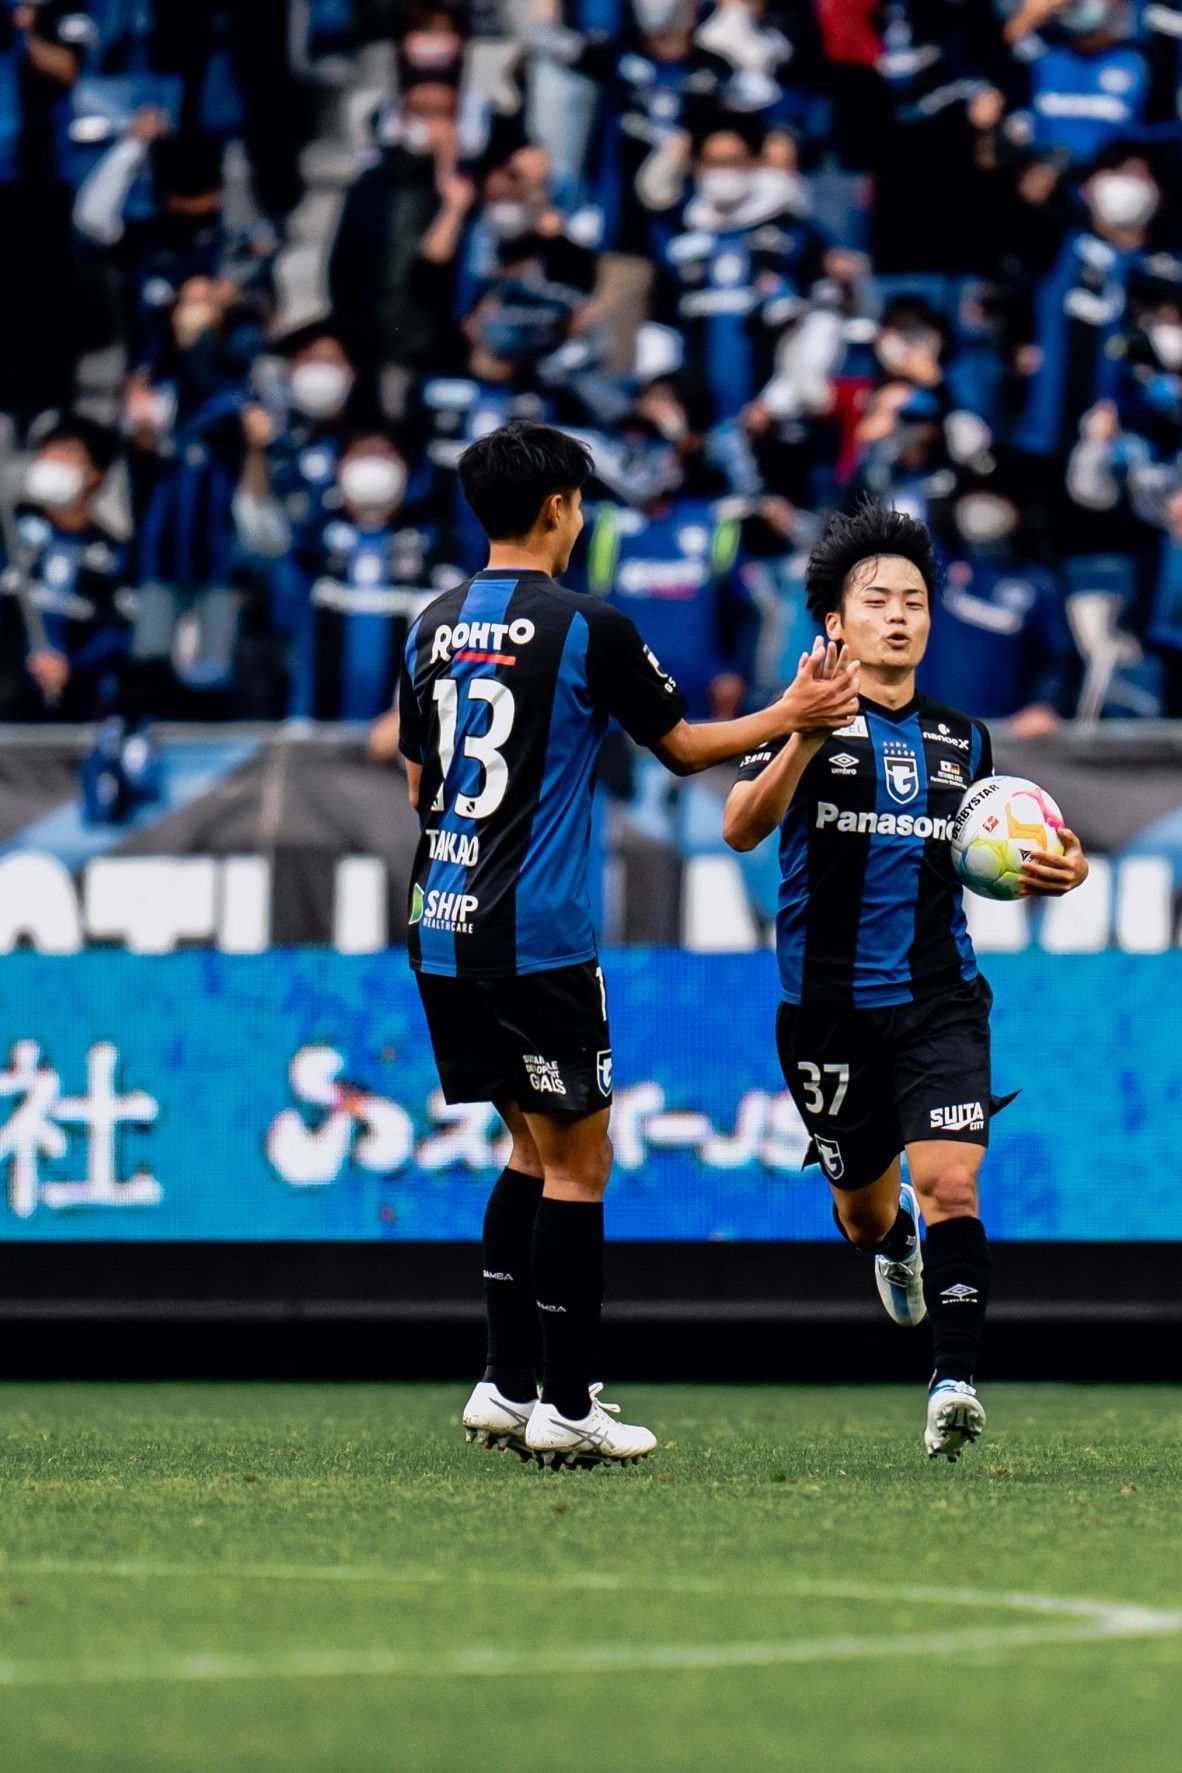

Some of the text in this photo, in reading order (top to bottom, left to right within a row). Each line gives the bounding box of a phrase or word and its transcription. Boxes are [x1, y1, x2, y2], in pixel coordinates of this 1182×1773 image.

[430, 618, 536, 664] ROHTO
[431, 677, 516, 819] 13
[952, 783, 1000, 840] DERBYSTAR
[425, 829, 479, 867] TAKAO
[425, 889, 479, 922] SHIP
[797, 1061, 850, 1116] 37
[930, 1102, 984, 1130] SUITA
[969, 1120, 984, 1131] CITY
